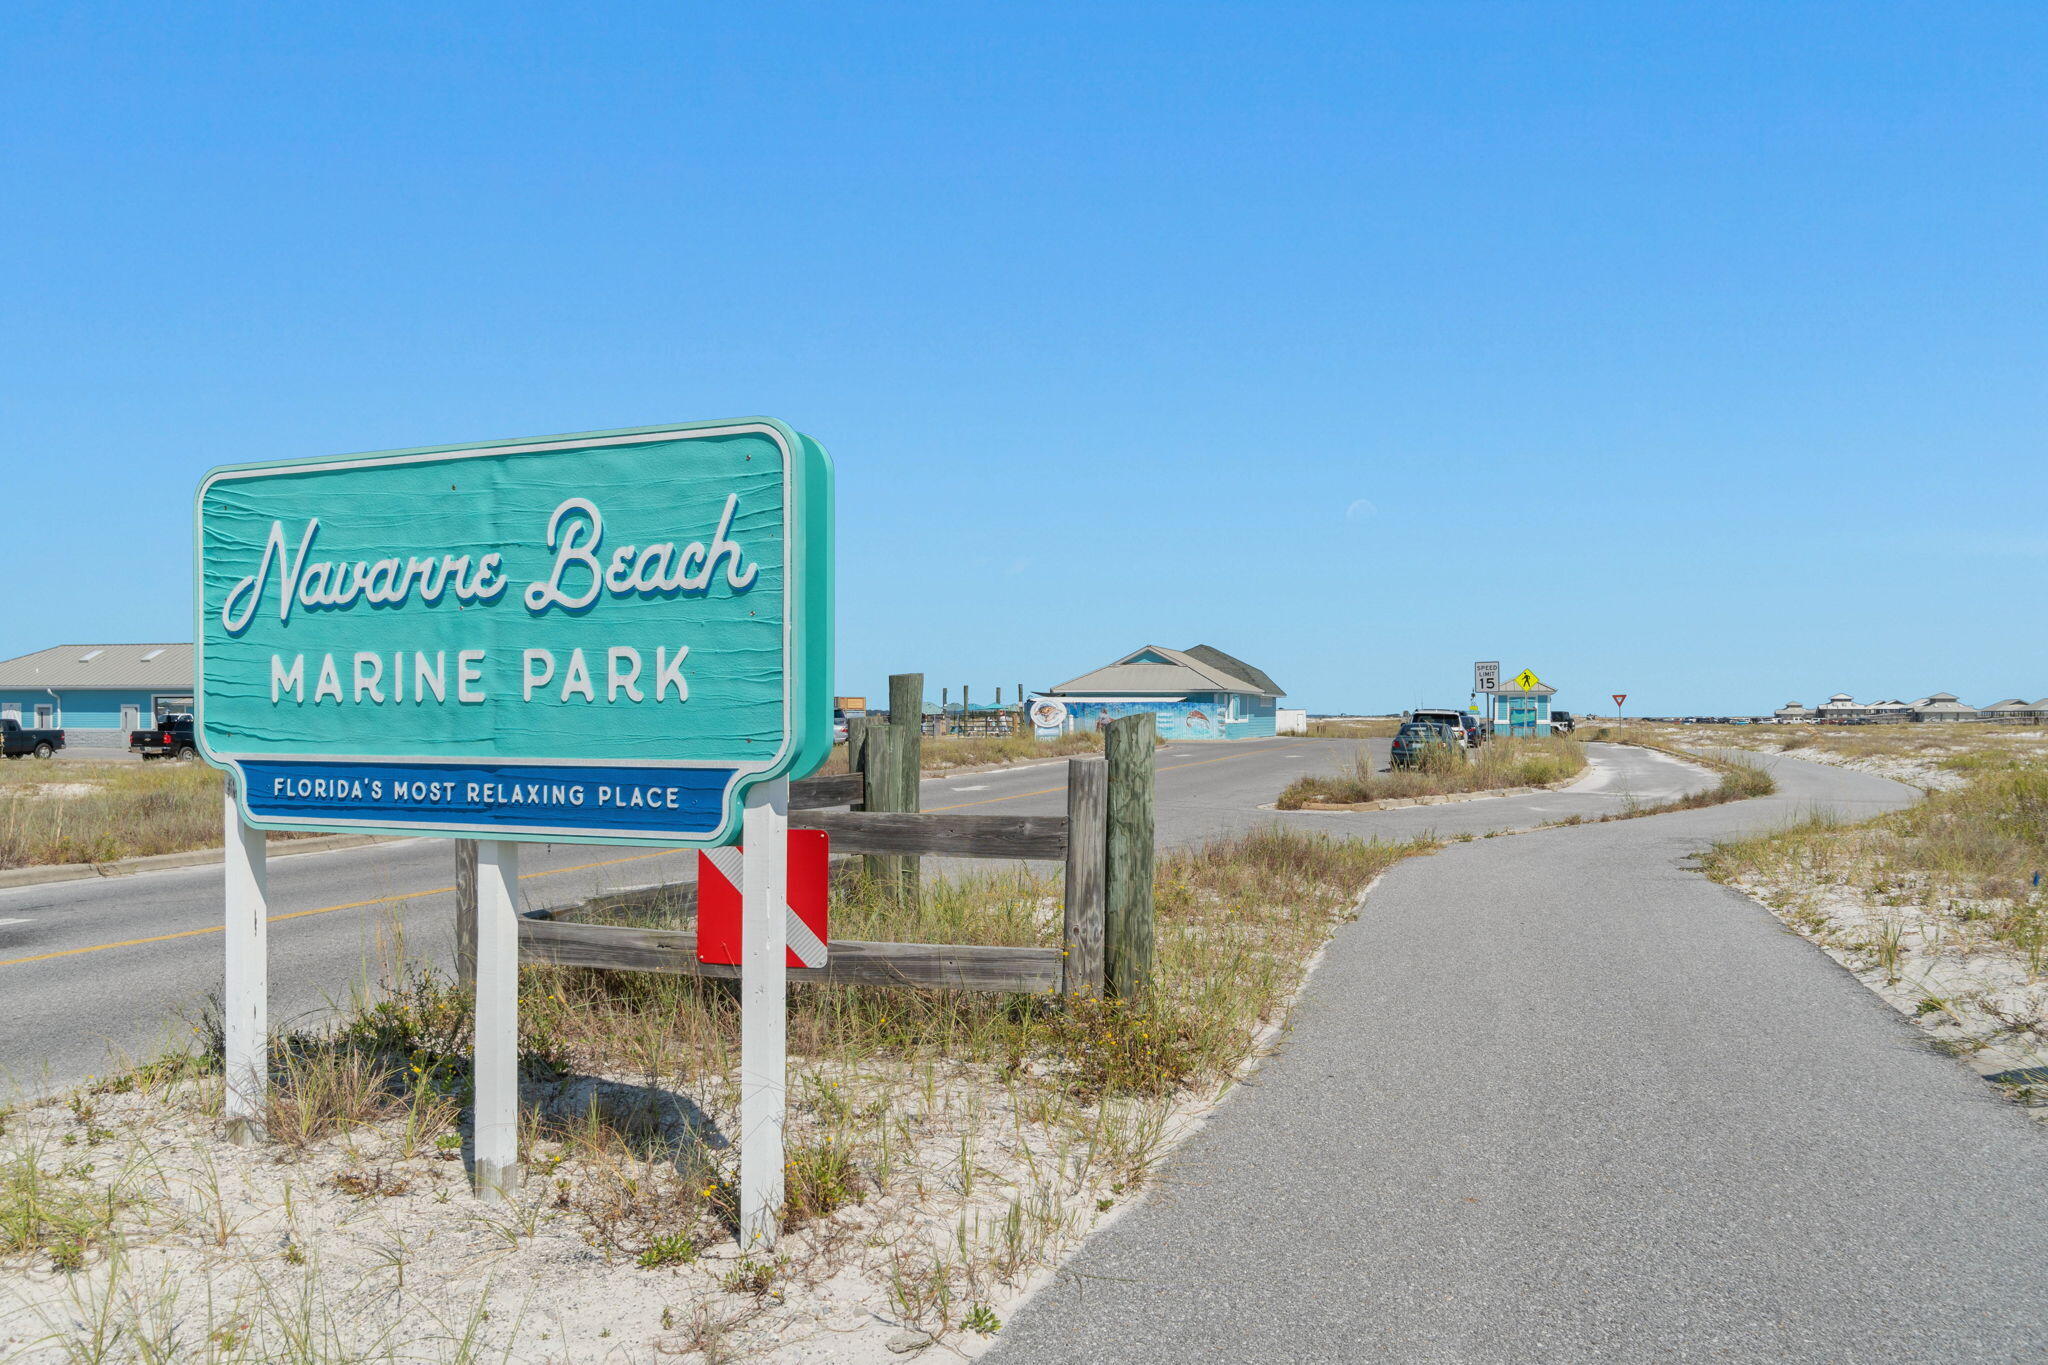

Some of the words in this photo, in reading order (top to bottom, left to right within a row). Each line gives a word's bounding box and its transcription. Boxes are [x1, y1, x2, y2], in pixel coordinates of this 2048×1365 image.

[222, 518, 506, 632] Navarre
[525, 494, 758, 611] Beach
[271, 650, 486, 702] MARINE
[524, 646, 689, 702] PARK
[1480, 678, 1495, 689] 15
[274, 778, 382, 799] FLORIDA'S
[394, 782, 455, 801] MOST
[467, 783, 584, 805] RELAXING
[598, 786, 680, 808] PLACE
